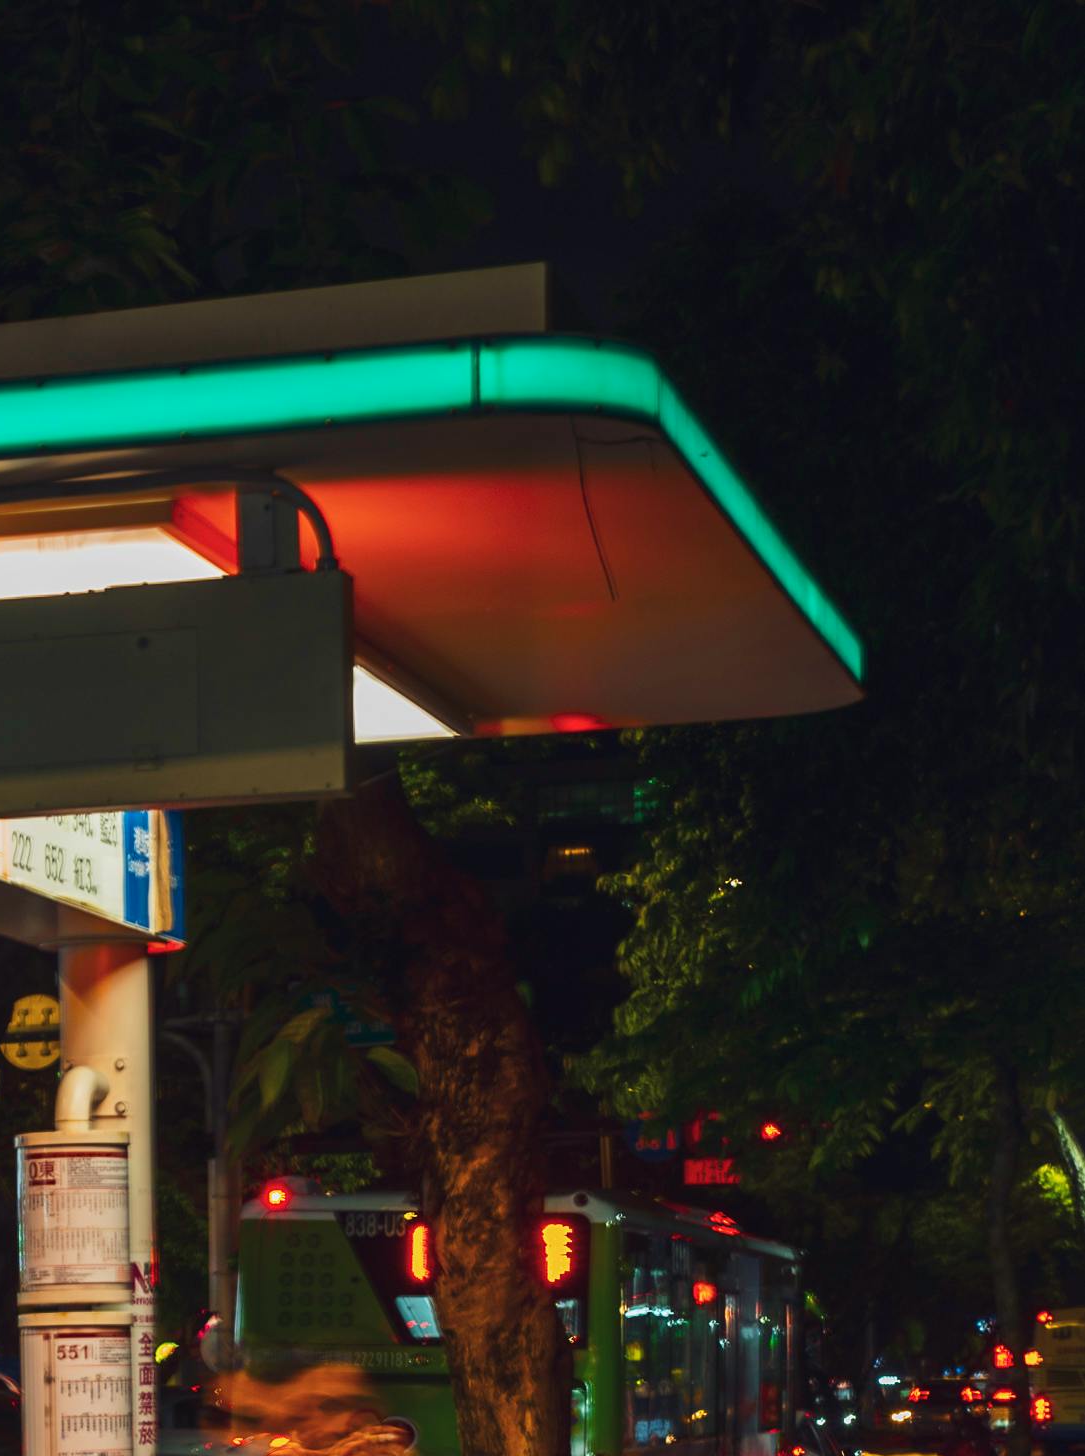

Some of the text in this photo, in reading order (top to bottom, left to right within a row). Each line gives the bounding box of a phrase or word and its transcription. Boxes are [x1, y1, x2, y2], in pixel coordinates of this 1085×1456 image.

[13, 831, 32, 872] 222
[45, 843, 64, 884] 652
[345, 1211, 407, 1237] 838-U3
[57, 1344, 89, 1361] 551
